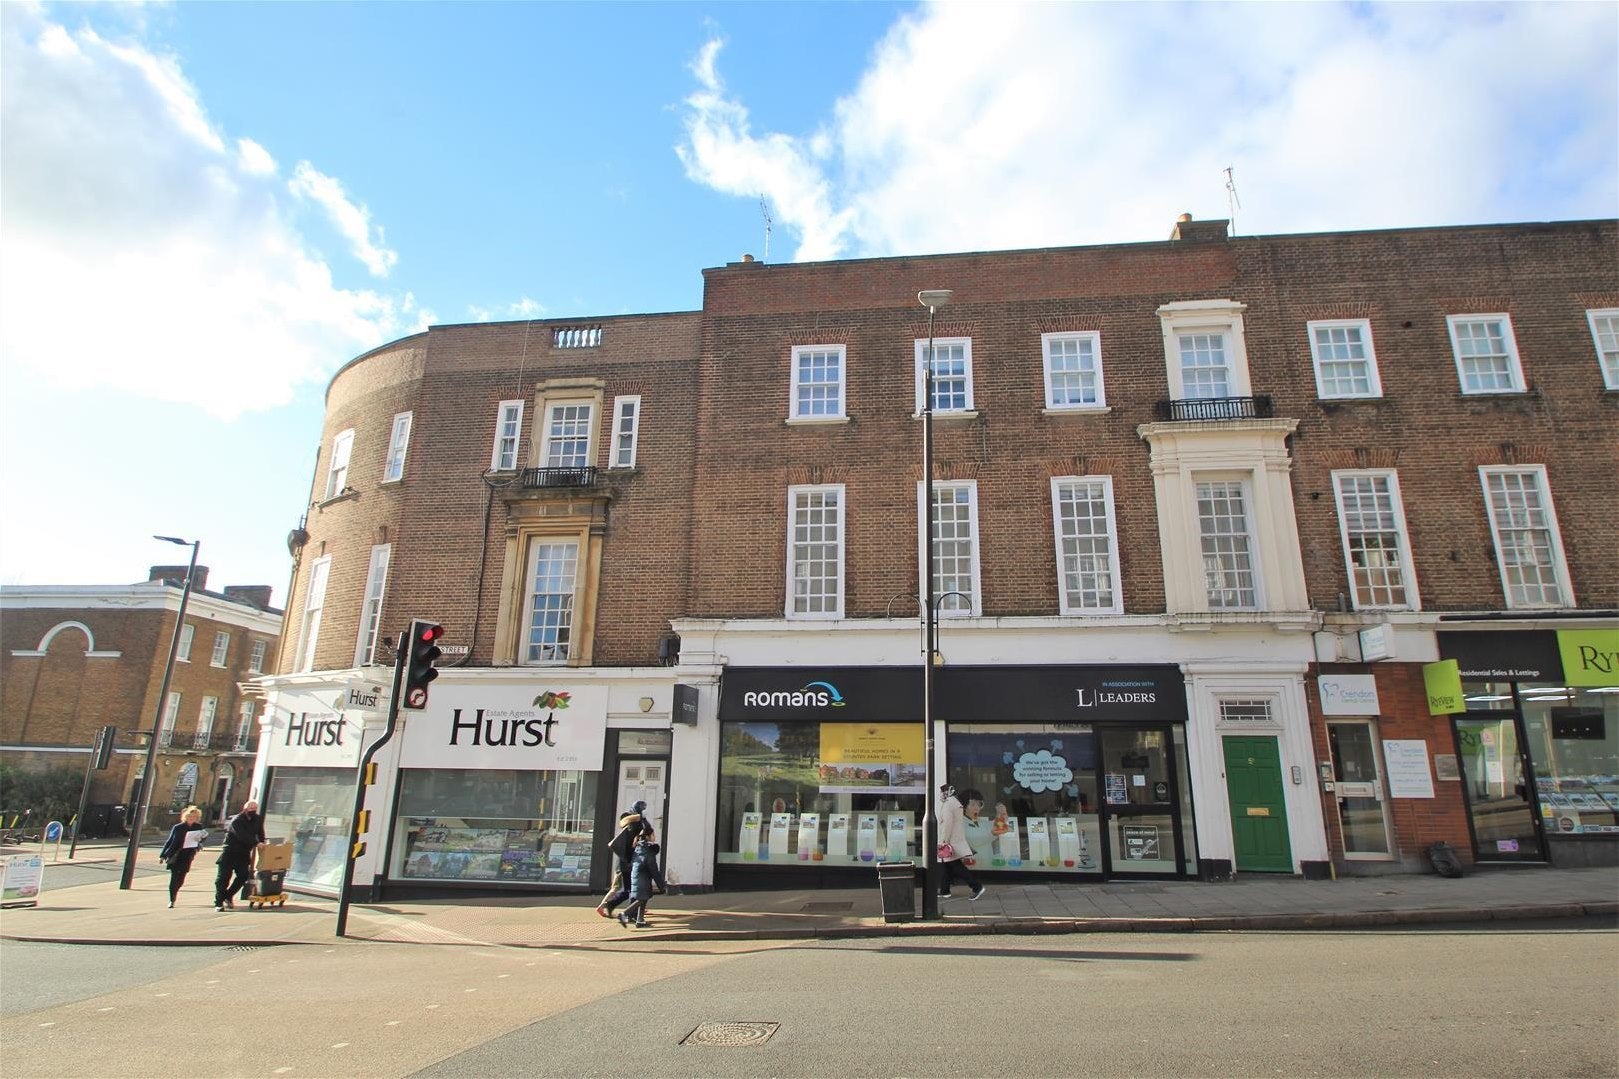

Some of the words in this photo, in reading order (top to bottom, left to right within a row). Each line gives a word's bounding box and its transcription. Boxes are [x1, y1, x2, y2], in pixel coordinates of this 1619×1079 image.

[440, 646, 466, 654] STREET
[349, 688, 377, 707] Hurst
[1099, 692, 1156, 703] LEADERS
[509, 710, 535, 718] Agents
[285, 712, 347, 746] Hurst
[449, 709, 559, 747] Hurst
